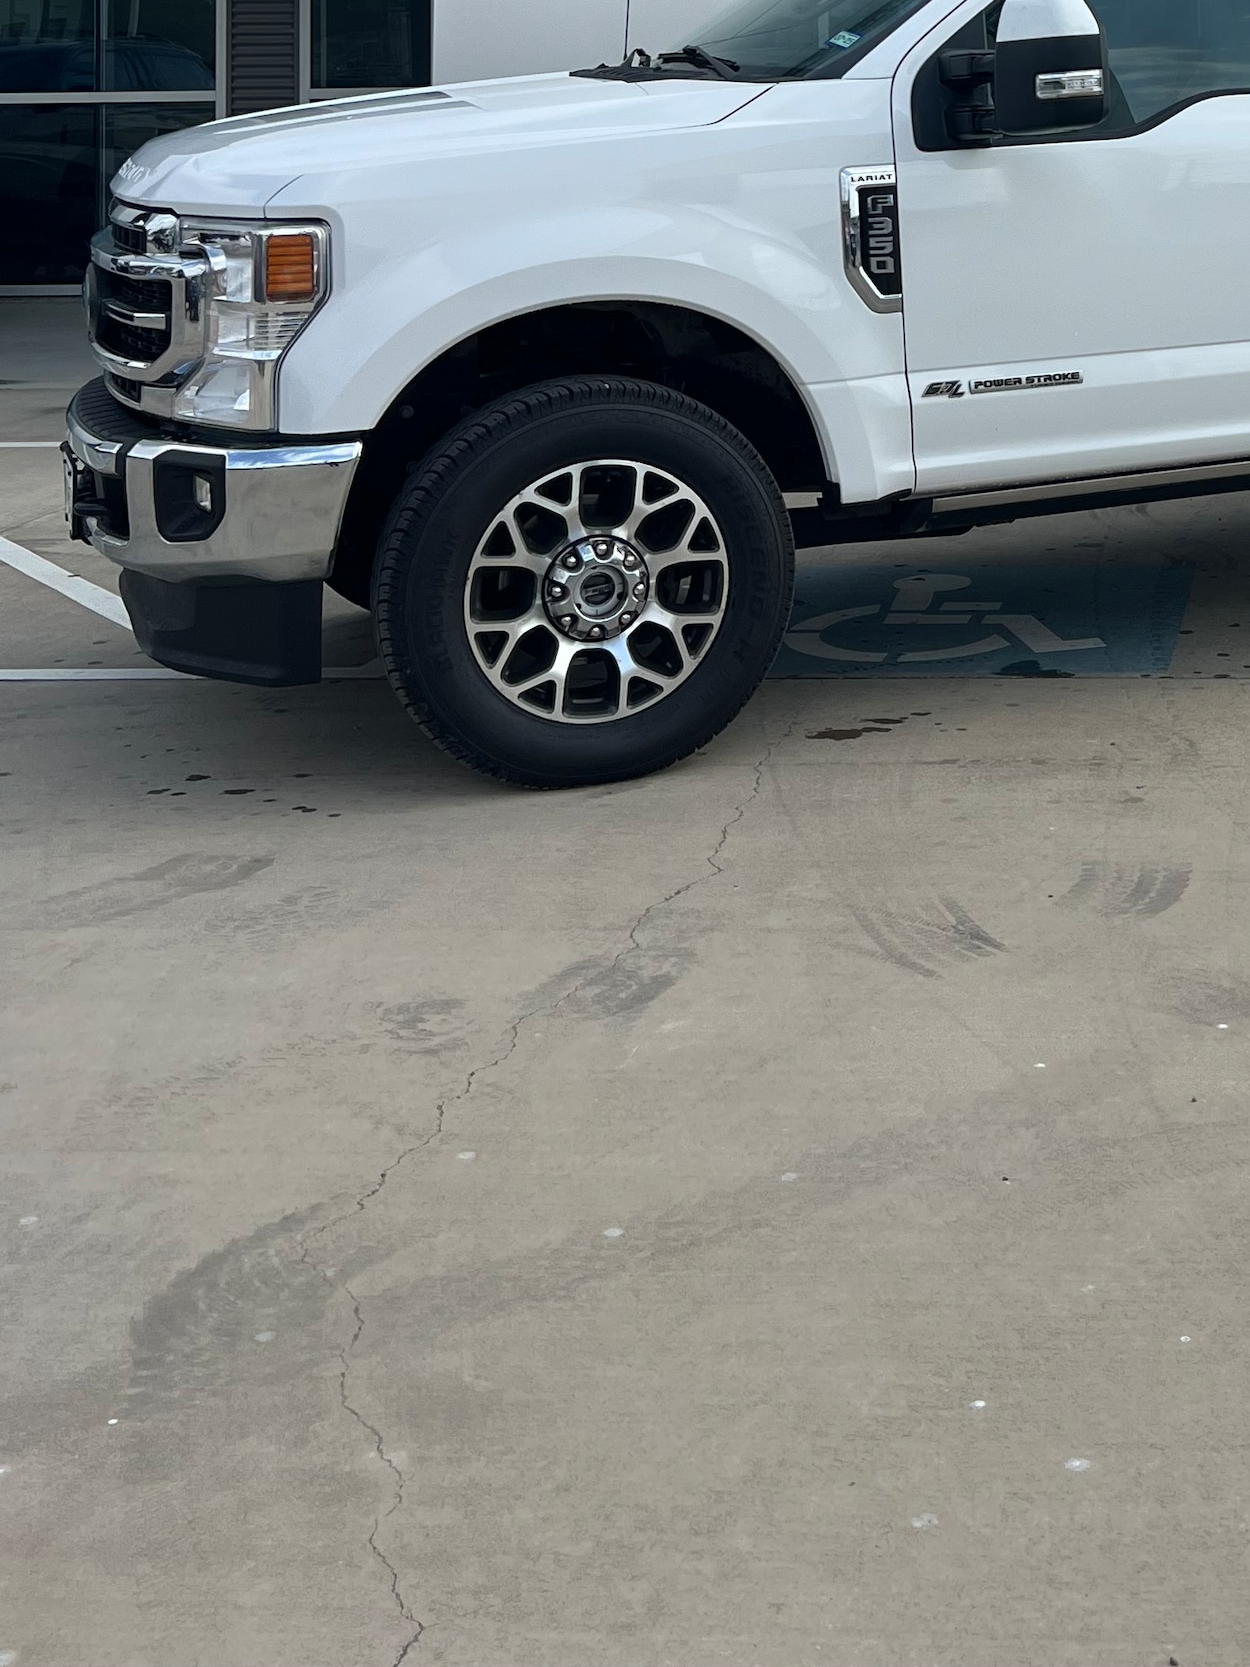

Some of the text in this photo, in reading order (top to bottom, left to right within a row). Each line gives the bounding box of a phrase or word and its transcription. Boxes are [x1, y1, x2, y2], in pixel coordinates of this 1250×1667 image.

[850, 173, 893, 183] LARIAT
[866, 193, 895, 275] F350
[973, 377, 1022, 389] POWER
[1025, 371, 1080, 384] STROKE
